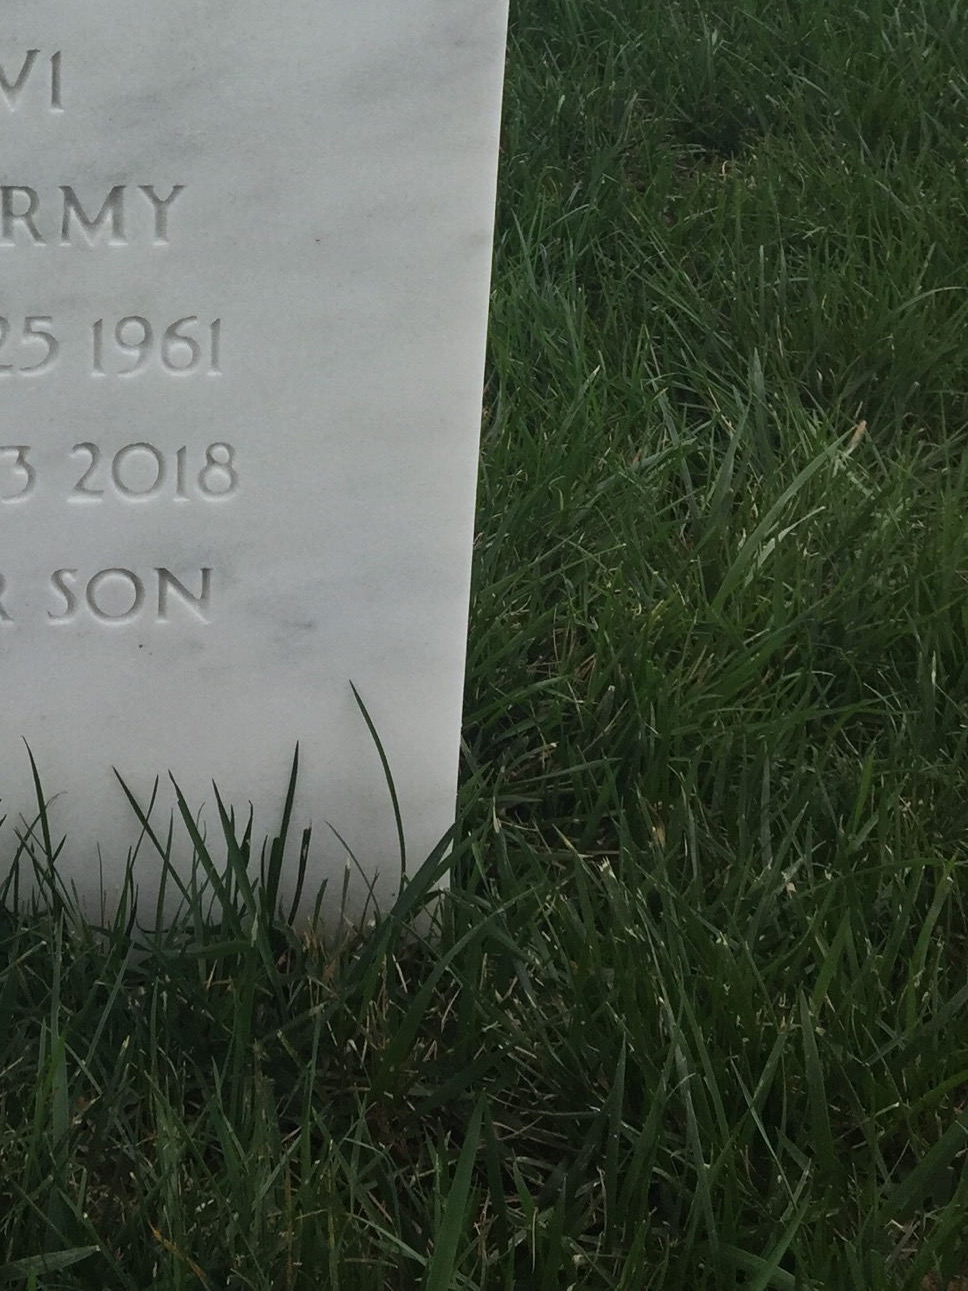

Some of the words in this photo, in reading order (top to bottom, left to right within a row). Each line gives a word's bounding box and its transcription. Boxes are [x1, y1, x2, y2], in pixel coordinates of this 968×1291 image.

[90, 315, 223, 378] 1961
[66, 441, 239, 504] 2018
[47, 567, 216, 627] SON
